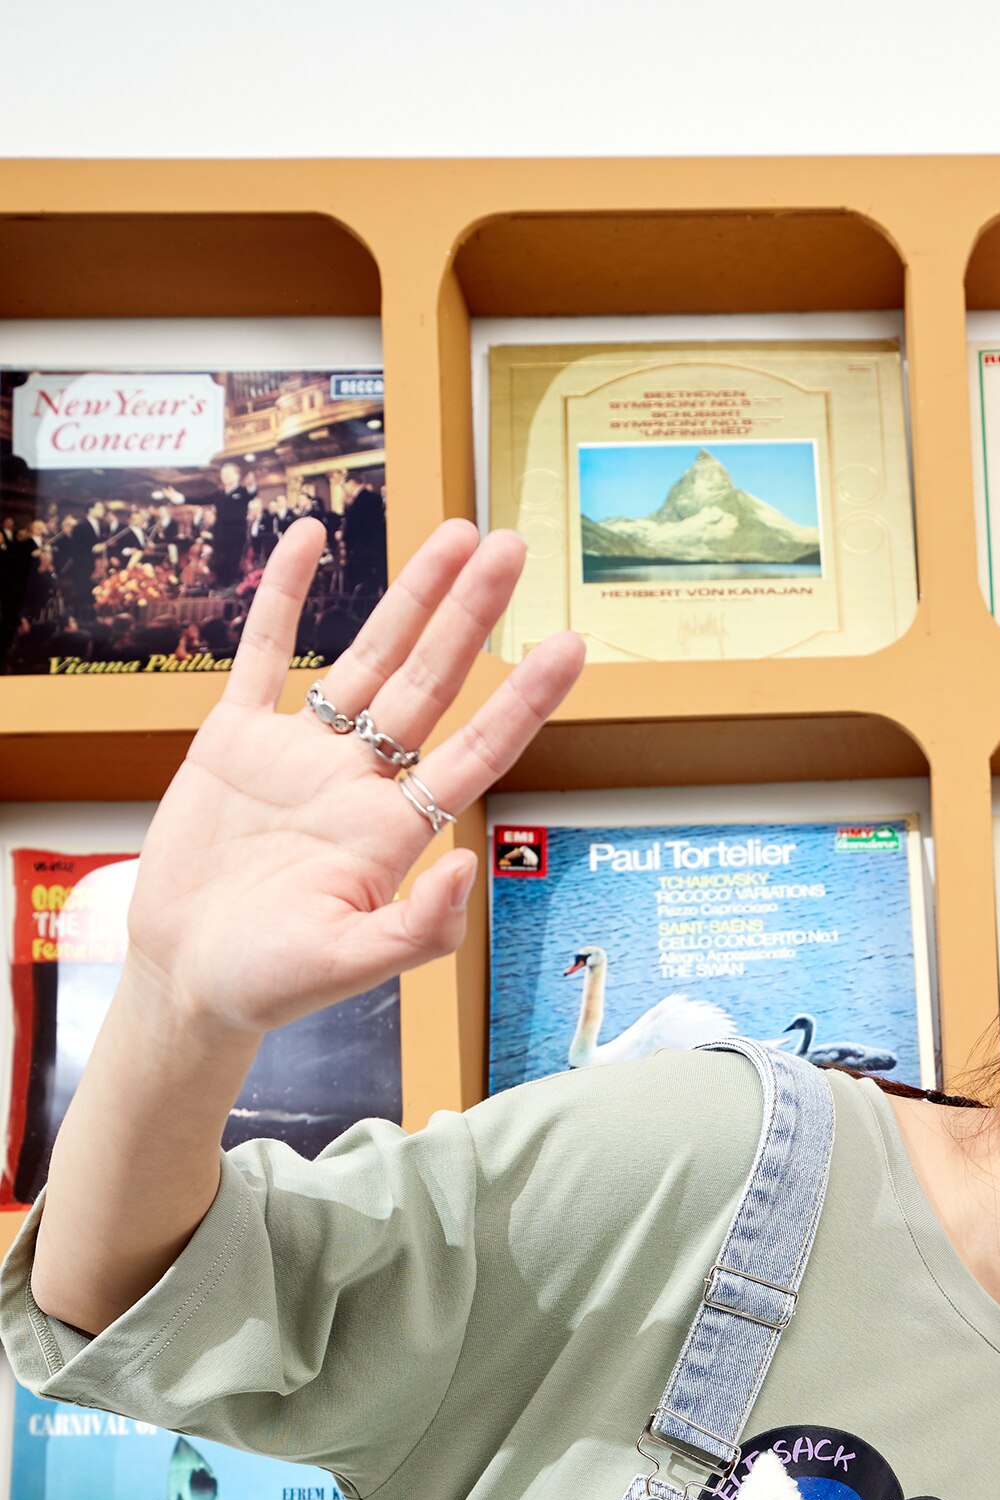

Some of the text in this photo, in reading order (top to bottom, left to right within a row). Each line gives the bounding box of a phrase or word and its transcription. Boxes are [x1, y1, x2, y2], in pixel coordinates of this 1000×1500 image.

[31, 387, 111, 417] New
[51, 421, 187, 452] Concert
[600, 586, 814, 598] HERBERT VON KARAJAN
[48, 656, 142, 674] Vienna
[503, 830, 535, 843] EMI
[588, 838, 797, 872] Paul Tortelier
[658, 872, 770, 890] TCHAIKOVSKY
[735, 884, 827, 901] VARIATIONS
[657, 935, 712, 950] CELLO
[714, 931, 807, 949] CONCERTO
[658, 951, 705, 966] Allegro
[660, 963, 746, 979] THE SWAN
[28, 1413, 129, 1436] CARNIVAL
[772, 1436, 857, 1473] SACK
[282, 1487, 325, 1500] EFREM
